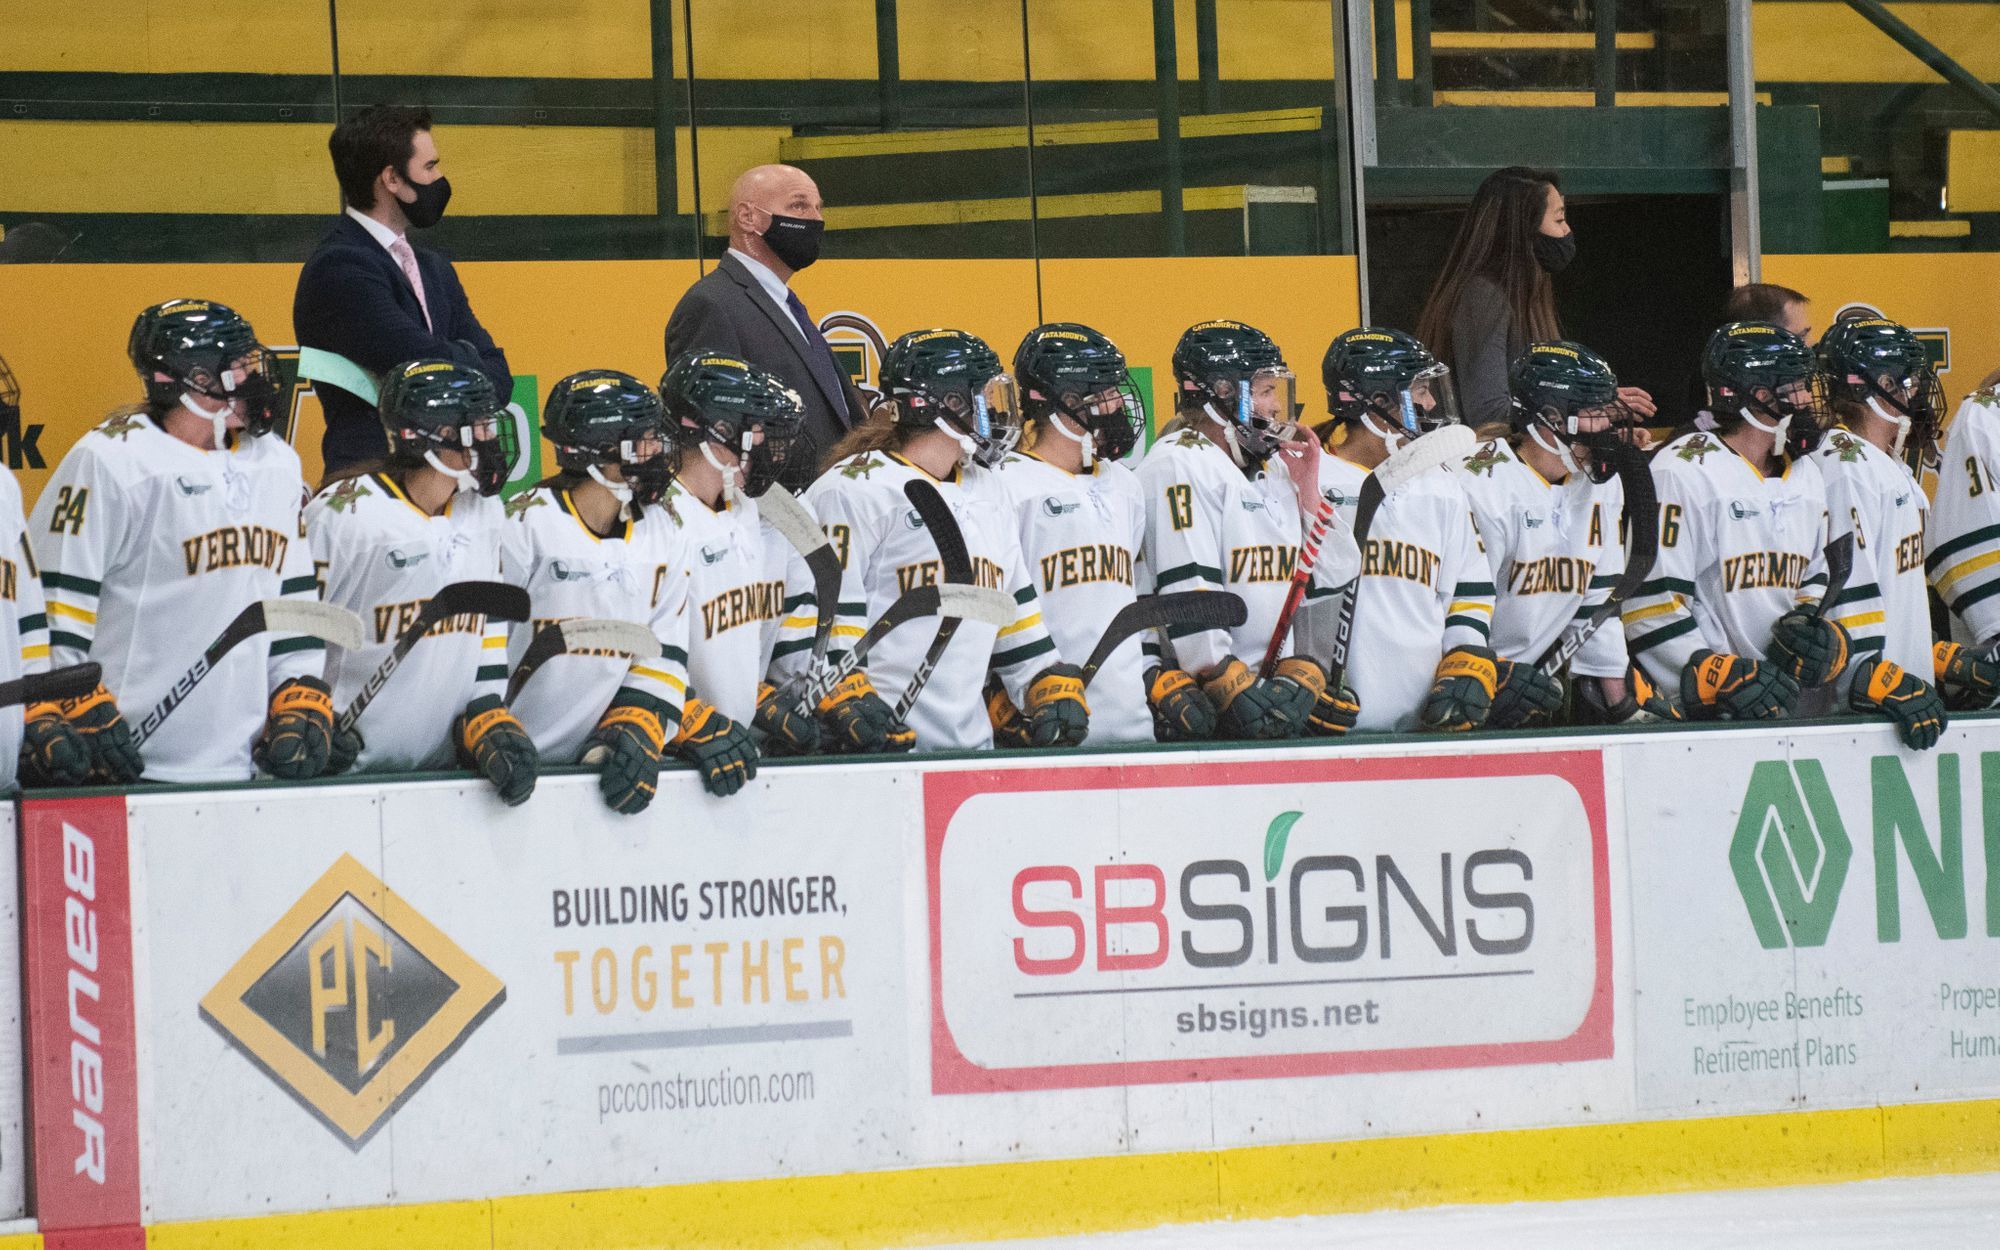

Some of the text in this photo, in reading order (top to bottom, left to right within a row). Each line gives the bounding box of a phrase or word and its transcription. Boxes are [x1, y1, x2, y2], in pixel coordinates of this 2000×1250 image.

[1345, 332, 1394, 343] CATAMOUNTS
[1531, 345, 1580, 360] CATAMOUNTS
[1728, 326, 1776, 337] CATAMOUNTS
[49, 483, 91, 536] 24
[1166, 484, 1194, 531] 13
[1588, 502, 1602, 548] A
[1871, 751, 2000, 943] N
[552, 875, 848, 928] BUILDING STRONGER,
[553, 935, 847, 1016] TOGETHER
[62, 821, 106, 1184] BAUER
[1176, 999, 1380, 1038] sbsigns.net
[1684, 986, 1864, 1031] Employee Benefits
[1694, 1037, 1857, 1076] Retirement Plans
[1951, 1030, 2000, 1059] Hum
[598, 1067, 815, 1125] pcconstruction.com
